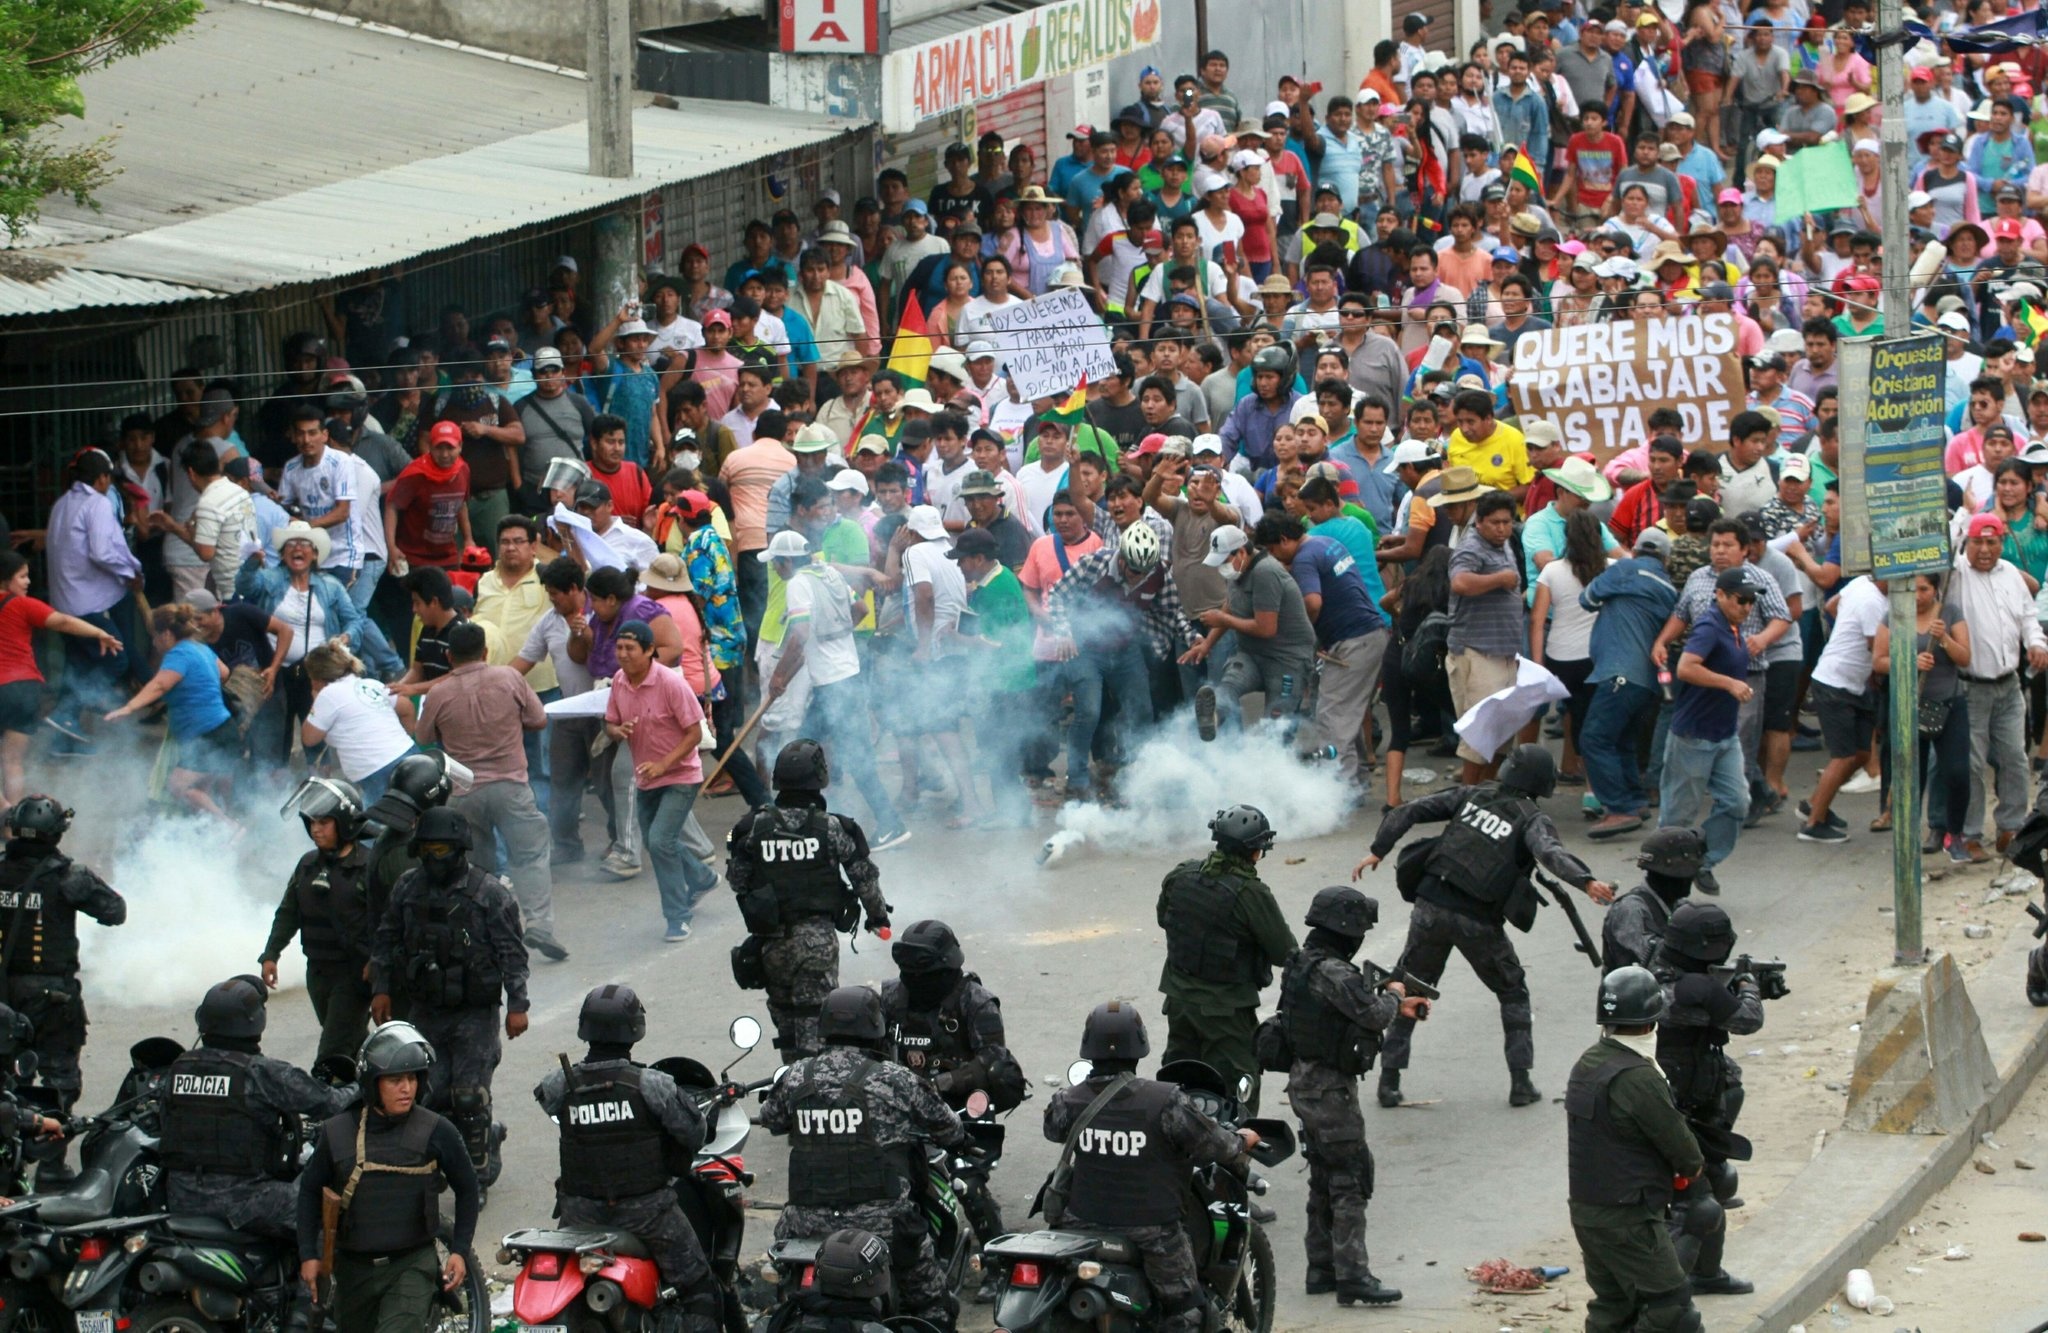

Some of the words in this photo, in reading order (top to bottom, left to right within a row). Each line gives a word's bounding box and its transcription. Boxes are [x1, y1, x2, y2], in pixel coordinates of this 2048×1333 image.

[1044, 0, 1132, 75] REGALOS
[1036, 351, 1052, 367] AL
[1054, 336, 1085, 358] PARO
[1073, 357, 1081, 369] A
[1086, 349, 1101, 365] LA
[1875, 346, 1943, 370] Orquesta
[1510, 355, 1726, 410] TRABAJAR
[1867, 393, 1943, 421] Adoración
[1677, 400, 1731, 443] DE
[761, 838, 819, 862] UTOP
[904, 1037, 930, 1046] UTOP
[174, 1075, 227, 1095] POLICIA
[569, 1100, 634, 1125] POLICIA
[797, 1108, 863, 1134] UTOP
[1079, 1128, 1146, 1156] UTOP
